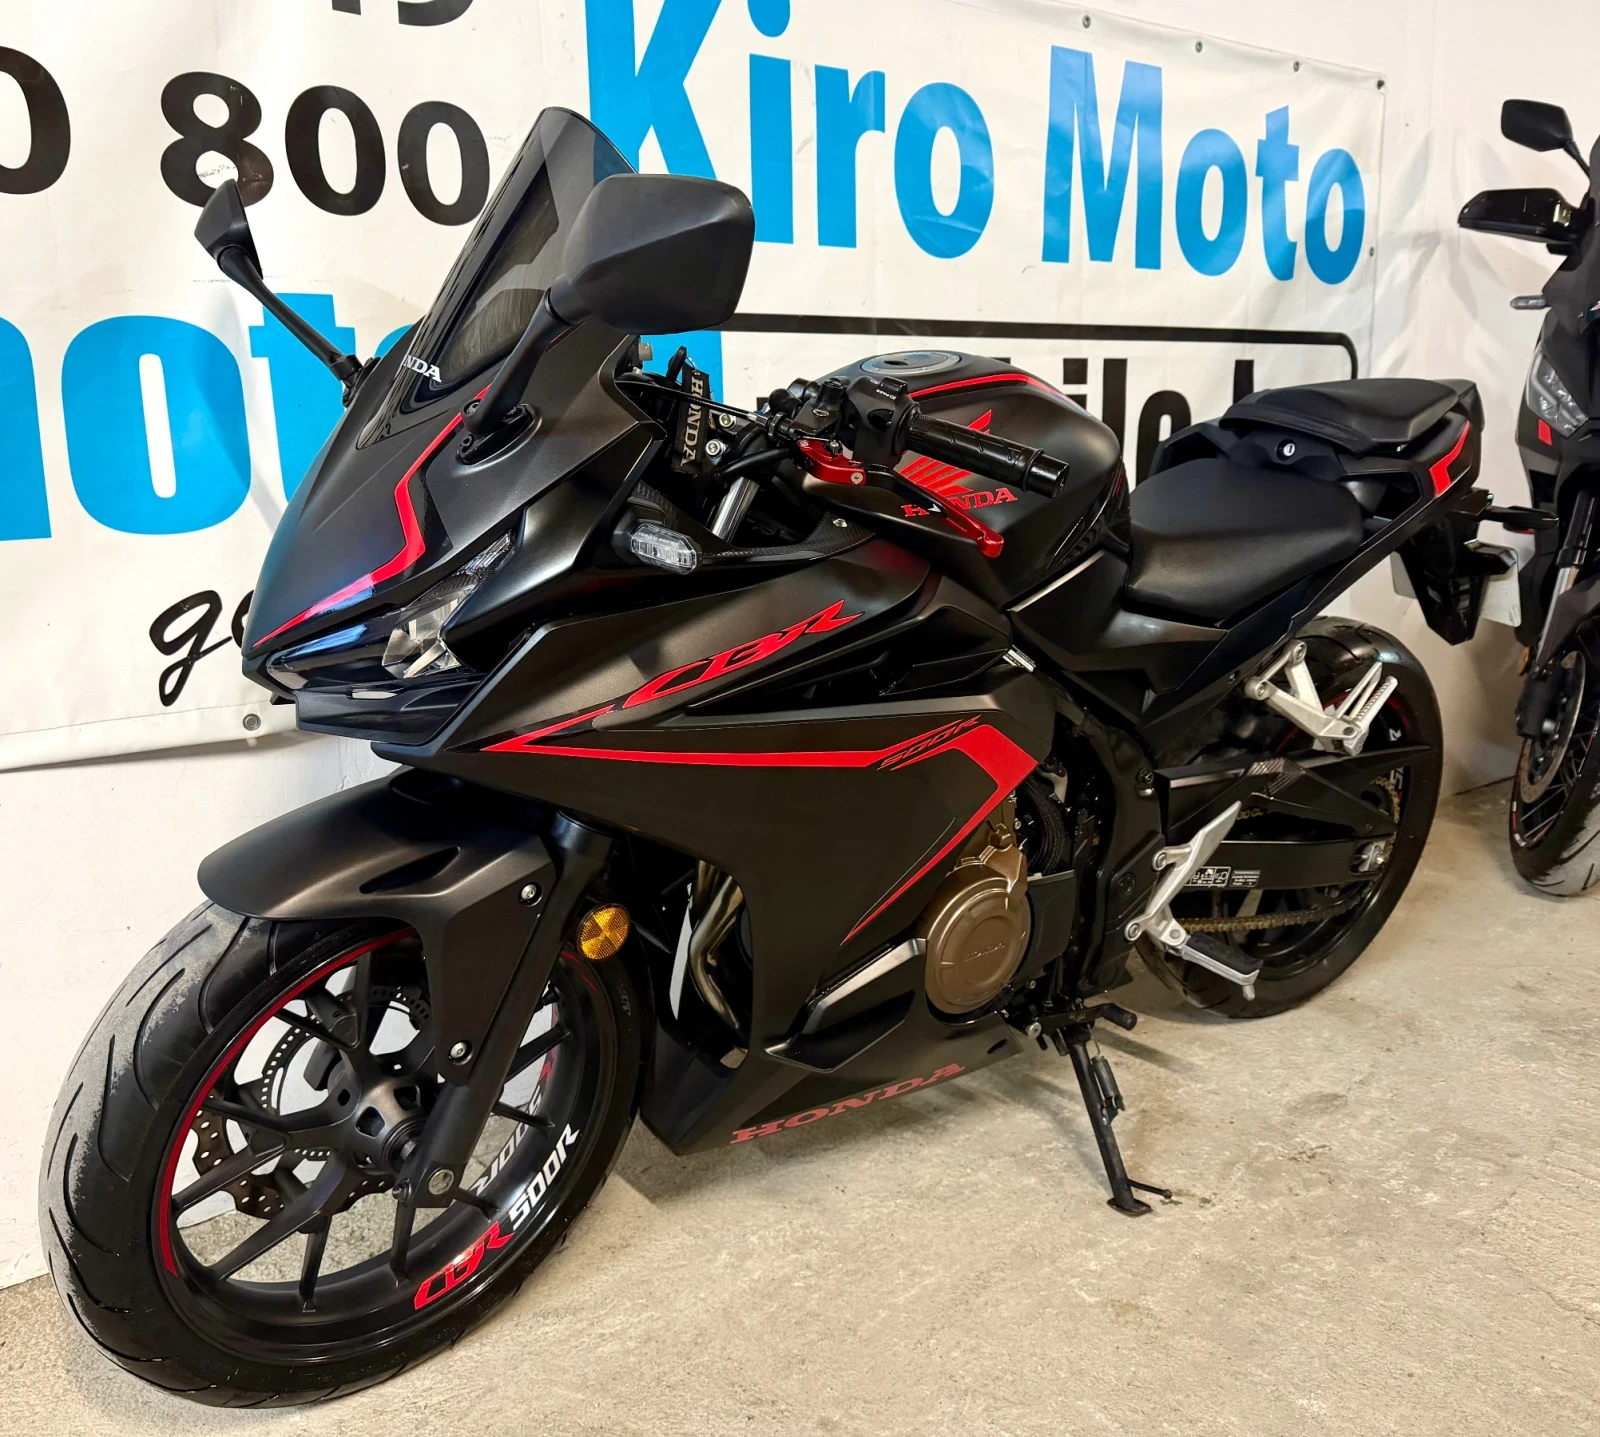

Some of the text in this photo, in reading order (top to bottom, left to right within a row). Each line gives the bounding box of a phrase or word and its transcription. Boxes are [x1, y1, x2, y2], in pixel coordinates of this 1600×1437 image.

[160, 71, 490, 226] 800
[585, 0, 1366, 285] Kiro Moto
[901, 487, 1018, 517] HNDA
[622, 599, 866, 709] CBR
[730, 1063, 966, 1144] HONDA
[414, 1123, 580, 1310] CBR 500R
